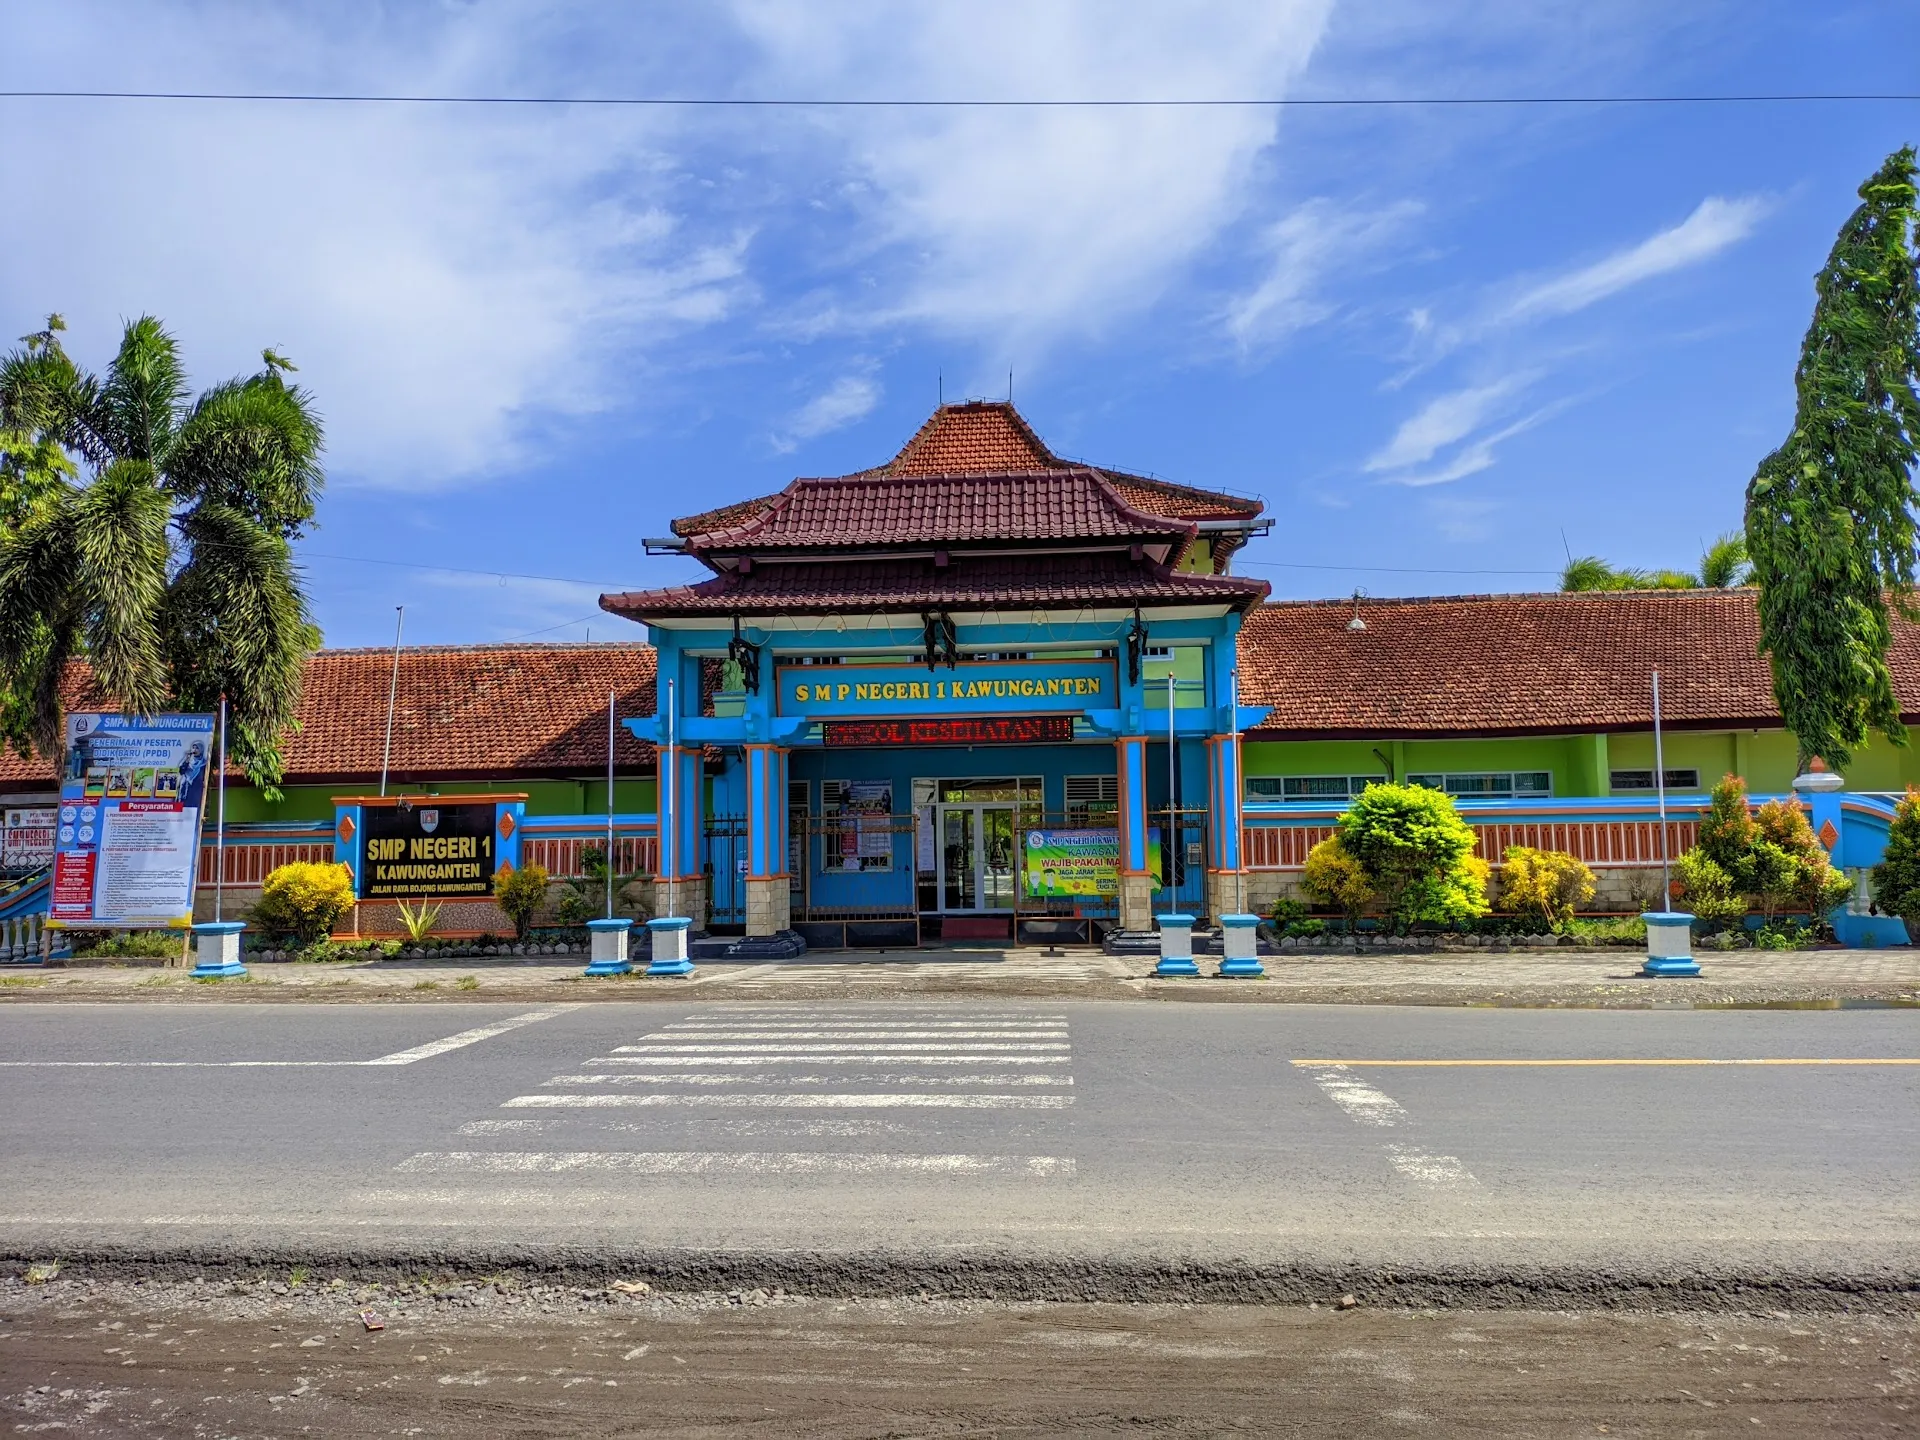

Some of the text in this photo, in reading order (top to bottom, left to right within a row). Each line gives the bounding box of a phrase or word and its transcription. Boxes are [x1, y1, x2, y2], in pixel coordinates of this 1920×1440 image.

[855, 681, 931, 701] NEGERI
[936, 680, 946, 699] 1
[951, 677, 1101, 699] KAWUNGANTEN
[909, 720, 1042, 742] KESEHATAN
[89, 739, 182, 747] PENERIMAAN PESERTA
[94, 749, 117, 758] DIDIK
[142, 749, 171, 758] (PPDB)
[128, 802, 173, 811] Persyaratan
[367, 835, 491, 861] SMP NEGERI 1
[1068, 847, 1119, 857] KAWASAN
[1041, 858, 1072, 867] WAJIB
[1074, 858, 1103, 867] PAKAI
[376, 863, 480, 880] KAWUNGANTEN
[370, 882, 487, 894] JALAN RAYA BOJONG KAWUNGANTEN
